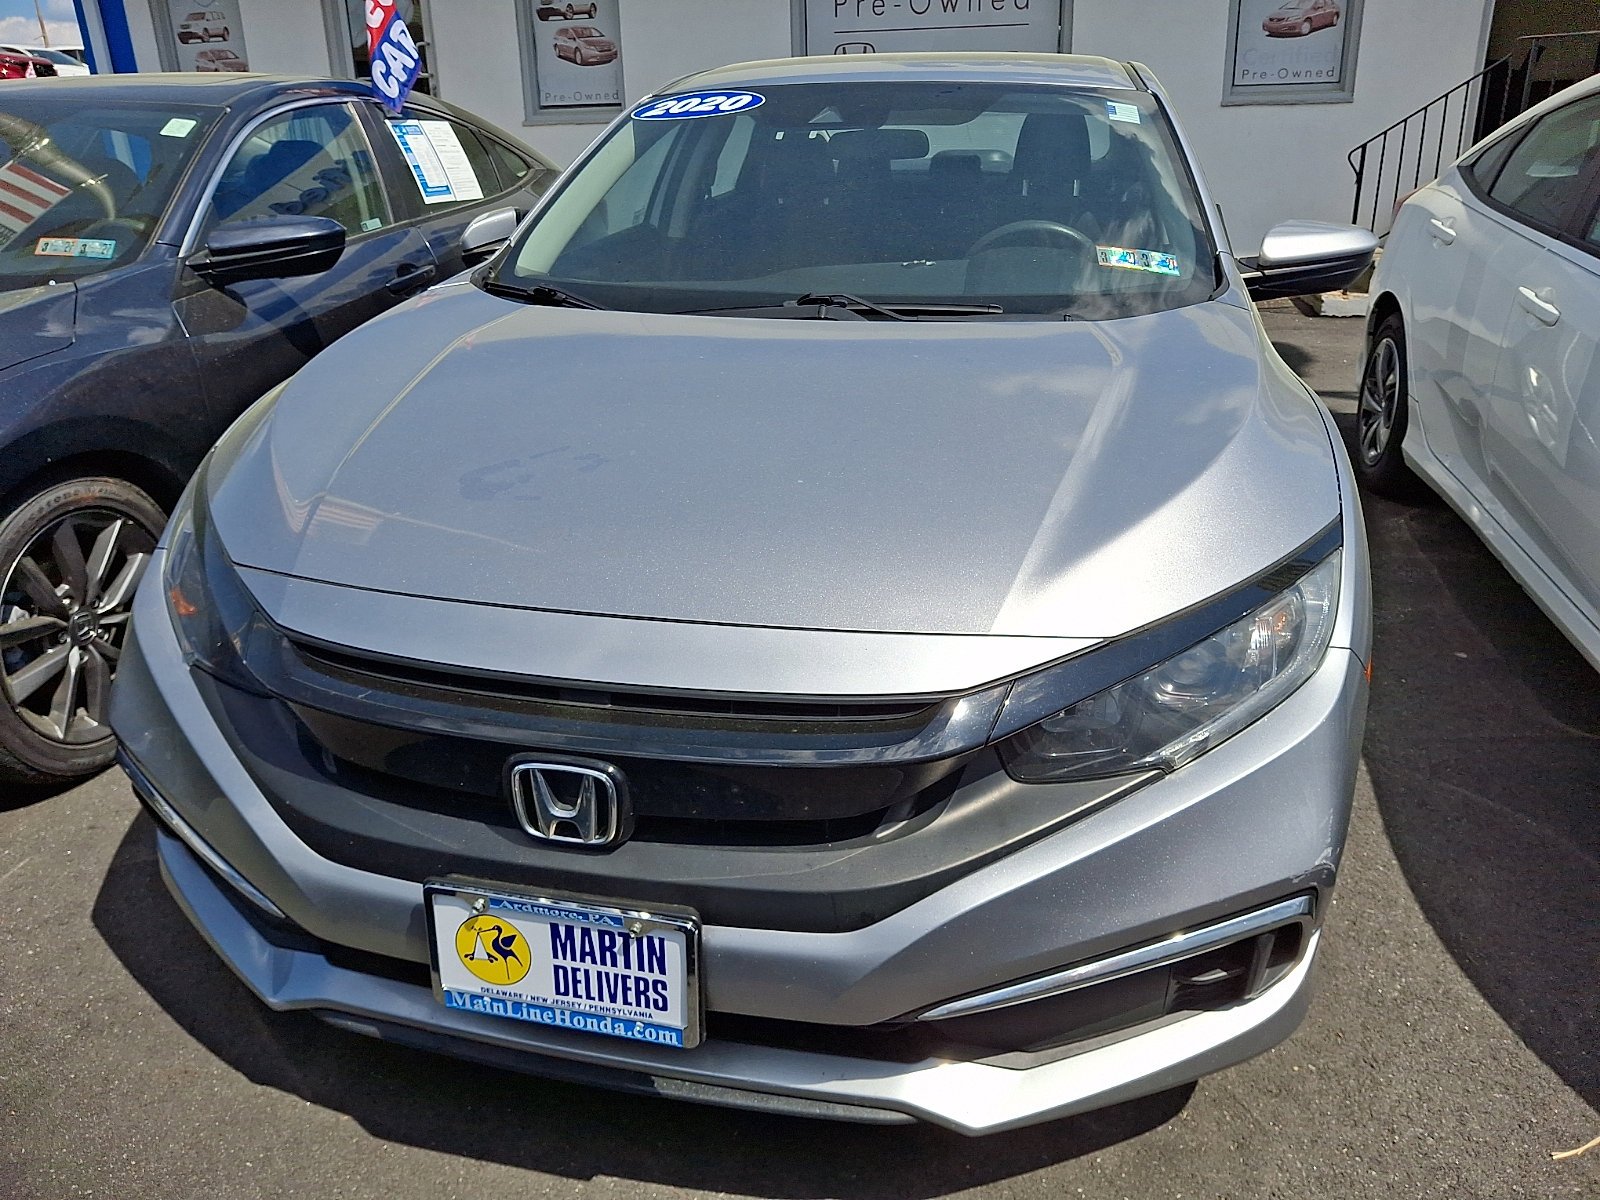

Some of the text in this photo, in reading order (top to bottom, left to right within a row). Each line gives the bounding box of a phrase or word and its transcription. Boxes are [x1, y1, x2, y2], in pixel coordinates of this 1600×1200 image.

[1241, 66, 1335, 80] Pre-Owned
[544, 89, 620, 102] Pre-Owned
[640, 95, 752, 118] 2020
[588, 913, 614, 926] PA
[549, 922, 667, 976] MARTIN
[553, 964, 669, 1012] DELIVERS
[480, 986, 523, 1000] DELAWARE
[530, 994, 549, 1004] NEW
[550, 999, 582, 1010] JERSEY
[588, 1003, 654, 1020] PENNSYLVANIA
[450, 990, 681, 1047] MainLineHonda.com
